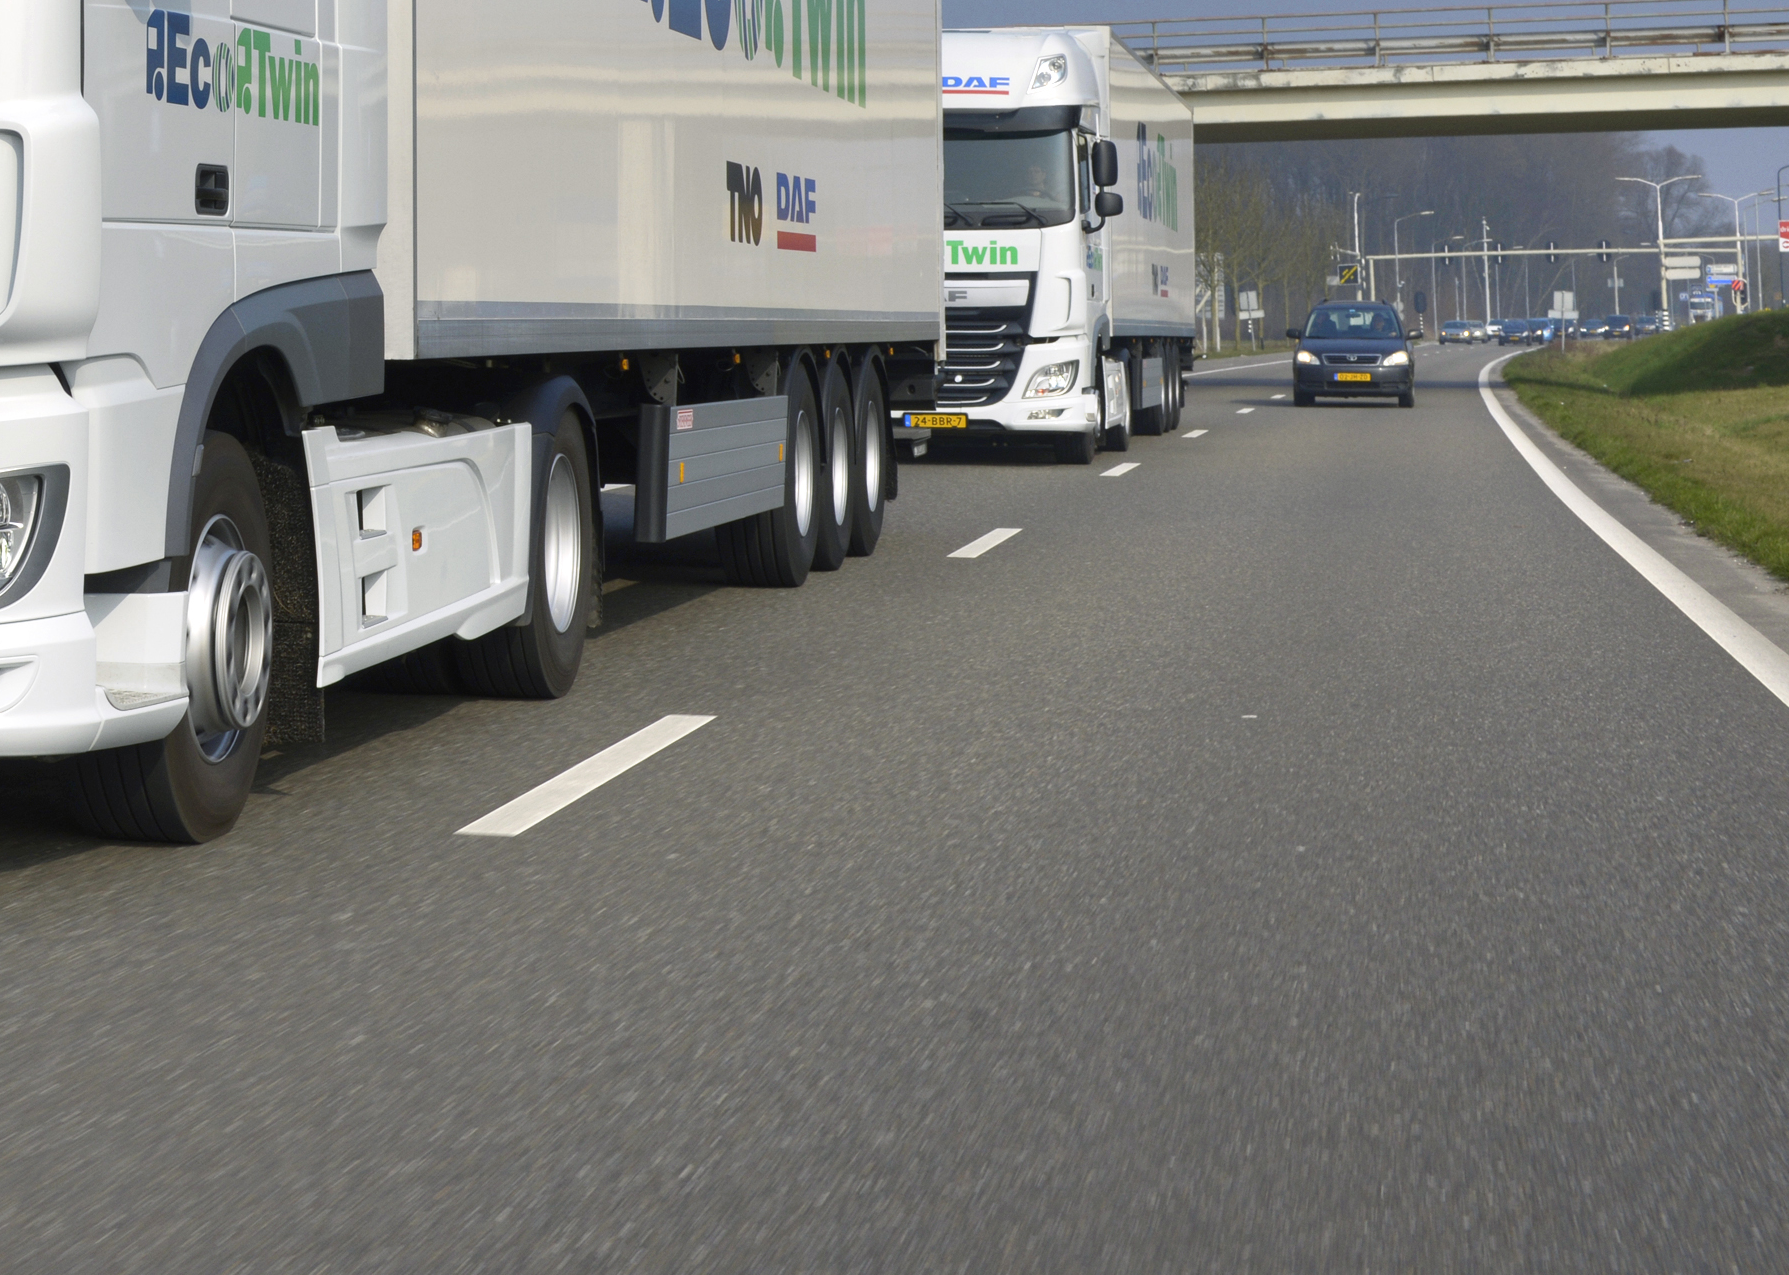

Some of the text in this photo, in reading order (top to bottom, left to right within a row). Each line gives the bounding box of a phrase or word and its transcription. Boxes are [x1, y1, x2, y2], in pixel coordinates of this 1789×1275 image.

[942, 76, 1011, 88] DAF
[726, 160, 763, 247] TNO
[776, 172, 817, 224] DAF
[914, 416, 962, 426] 24-BBR-7
